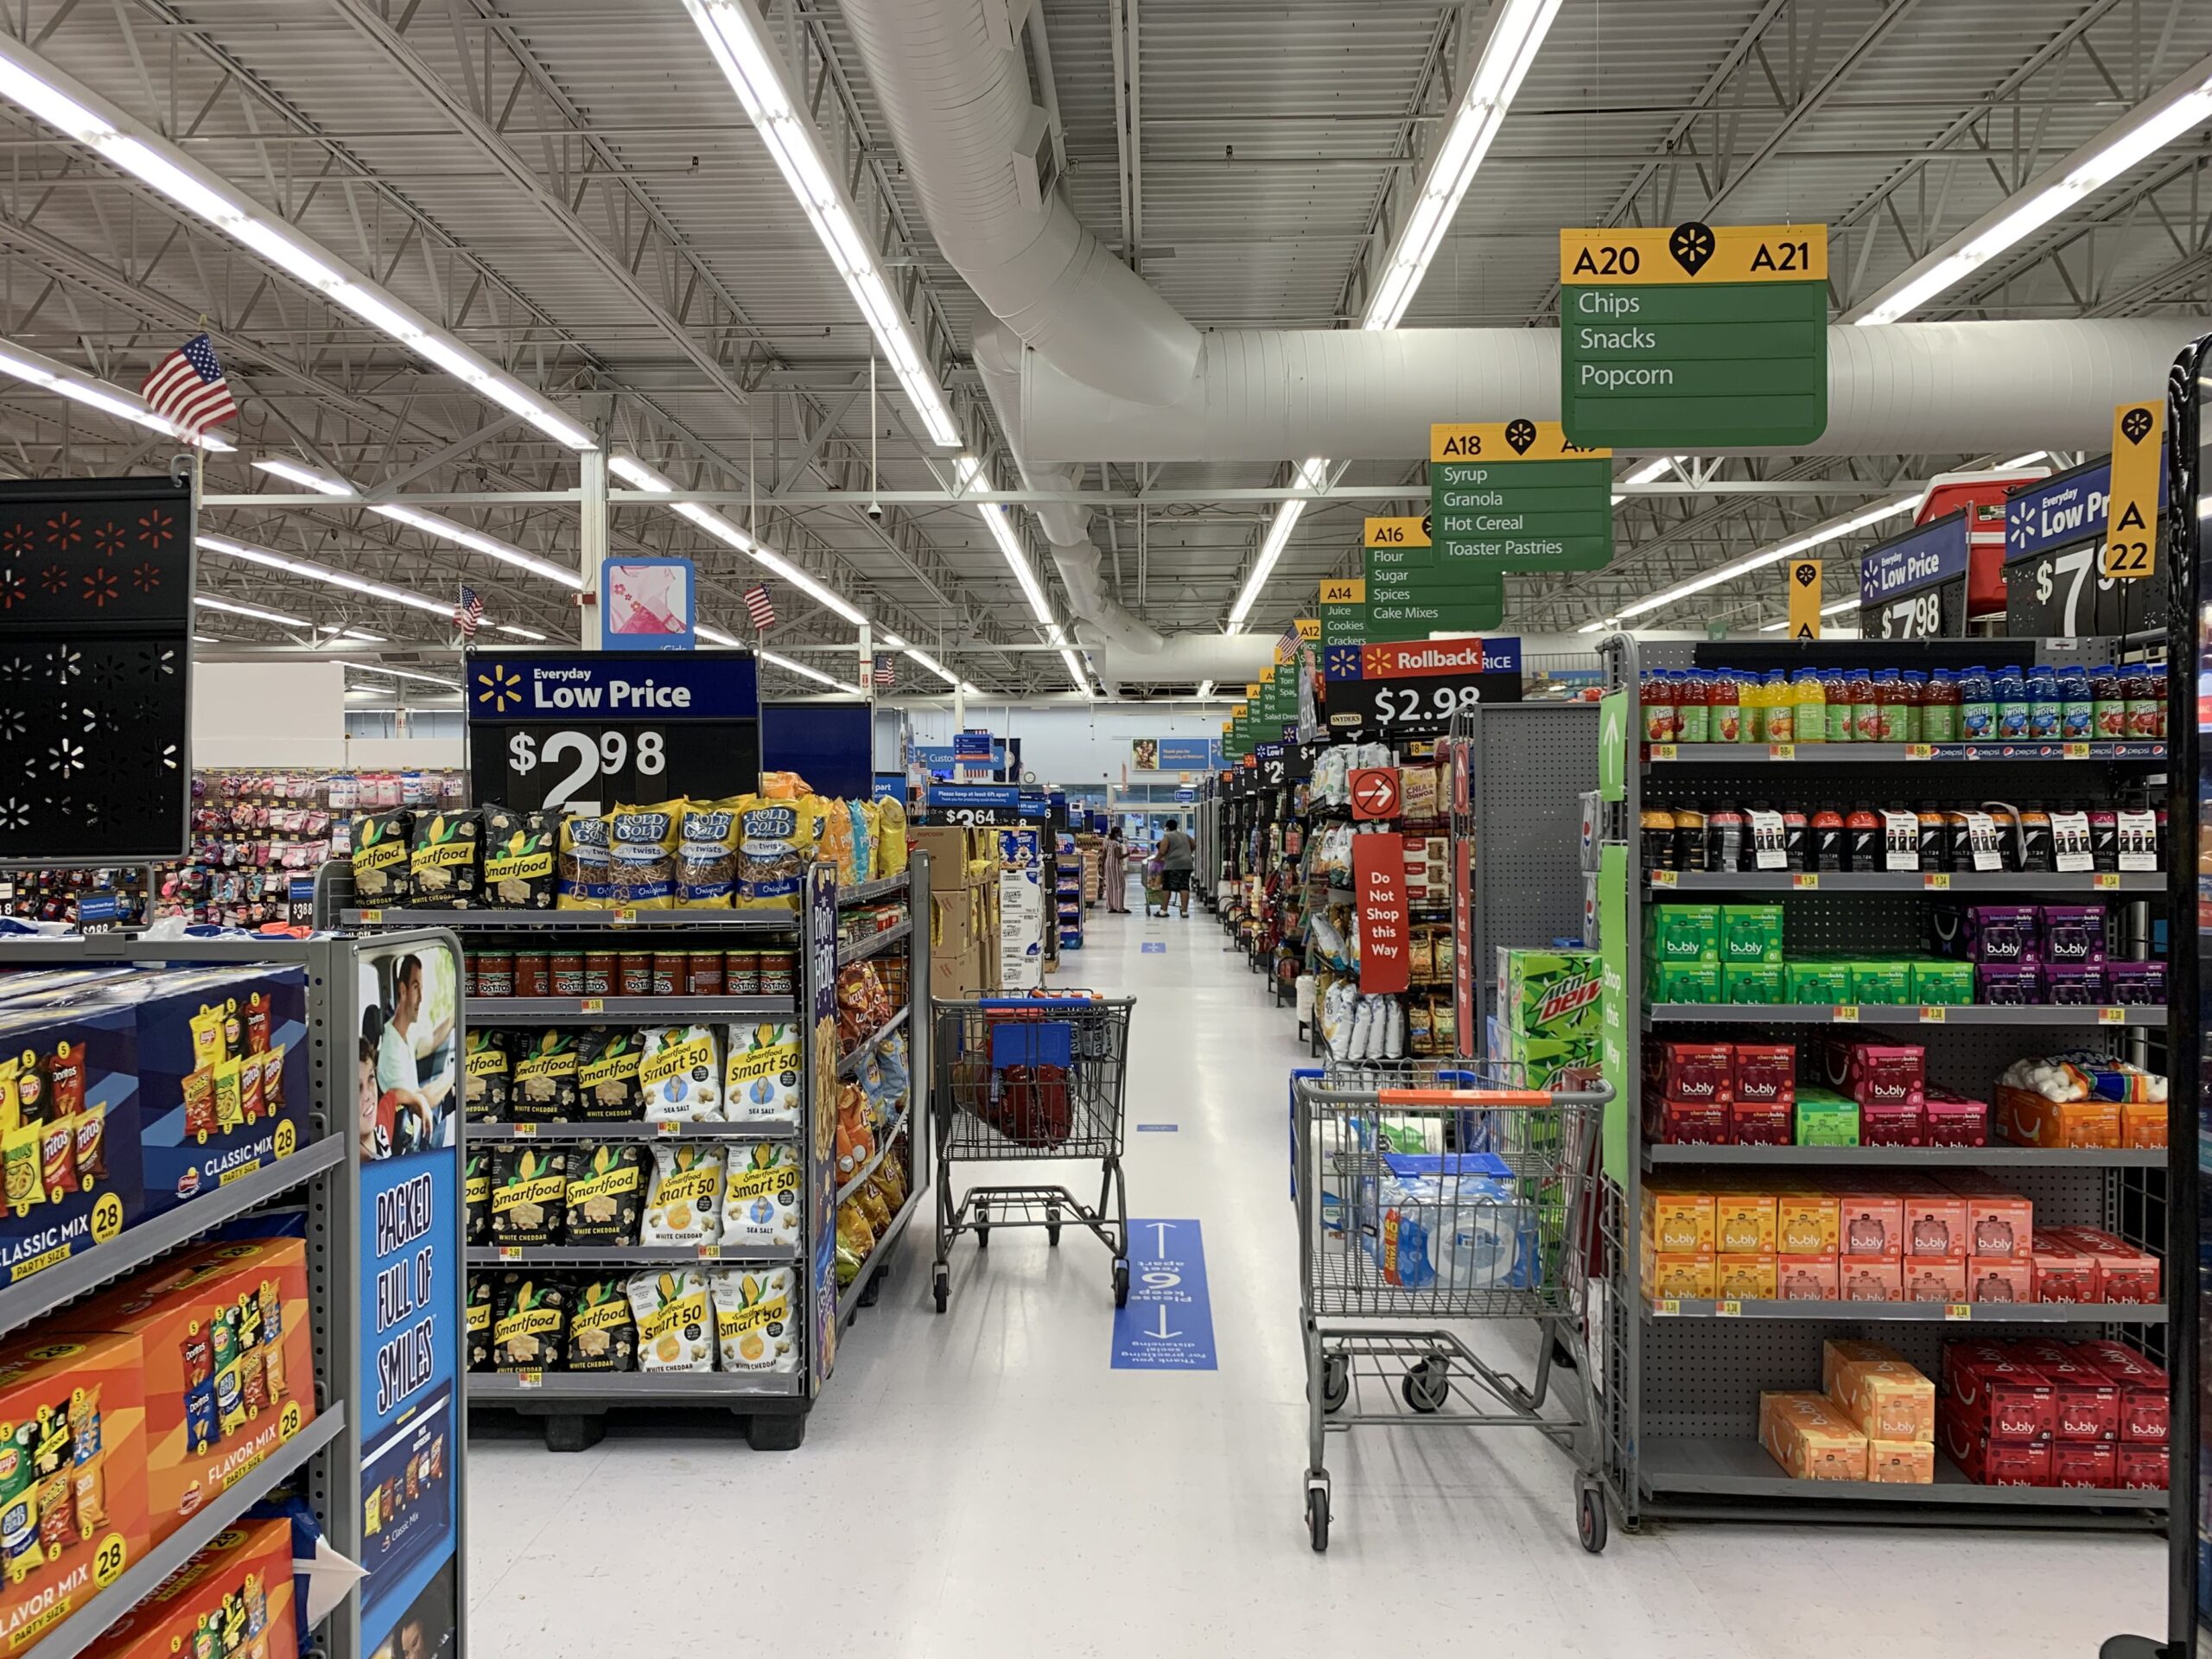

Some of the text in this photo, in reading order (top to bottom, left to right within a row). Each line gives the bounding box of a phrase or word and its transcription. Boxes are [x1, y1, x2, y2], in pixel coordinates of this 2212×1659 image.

[1573, 246, 1640, 275] A20
[1750, 242, 1809, 272] A21
[1579, 292, 1640, 315] Chips
[1580, 328, 1656, 349] Snacks
[1581, 365, 1674, 390] Popcorn
[1443, 436, 1482, 455] A18
[1444, 467, 1488, 485] Syrup
[1444, 492, 1503, 507] Granola
[2042, 488, 2078, 509] Everyday
[1444, 516, 1523, 531] Hot Cereal
[2042, 505, 2083, 537] Low
[2116, 501, 2145, 531] A
[1374, 527, 1404, 543] A16
[1374, 551, 1404, 562] Flour
[1446, 540, 1562, 556] Toaster Pastries
[2110, 543, 2147, 571] 22
[1881, 553, 1902, 567] Everyday
[1374, 570, 1408, 583] Sugar
[1881, 553, 1939, 591] Low Price
[1327, 588, 1351, 600] A14
[1374, 589, 1410, 601] Spices
[1327, 607, 1351, 616] Juice
[1374, 607, 1439, 619] Cake Mixes
[1300, 626, 1319, 636] A12
[1327, 620, 1363, 631] Cookies
[1327, 636, 1366, 645] Crackers
[1398, 648, 1511, 670] Rollback RICE
[534, 668, 591, 681] Everyday
[534, 679, 690, 709] Low Price
[1375, 686, 1480, 725] $2.98
[929, 753, 954, 762] Custo
[1406, 785, 1425, 795] CHIA
[1406, 790, 1433, 799] QUINOA
[752, 809, 790, 821] ROLD
[745, 820, 790, 836] GOLD
[412, 847, 469, 868] martfood
[632, 847, 661, 855] twists
[485, 857, 547, 878] Smartfood
[1371, 872, 1390, 884] Do
[762, 882, 791, 893] Original
[1370, 890, 1394, 902] Not
[294, 903, 313, 919] $388
[1367, 908, 1399, 922] Shop
[815, 906, 834, 944] PARTY
[1372, 926, 1396, 938] this
[1372, 944, 1398, 958] Way
[1667, 941, 1700, 954] bubly
[2055, 943, 2087, 956] bubly
[815, 944, 835, 998] HERE
[1605, 963, 1621, 996] Shop
[1606, 1002, 1618, 1027] this
[690, 1048, 708, 1064] 50
[1606, 1037, 1620, 1071] Way
[54, 1066, 77, 1082] Doritos
[731, 1054, 798, 1081] Smart 50
[667, 1122, 678, 1132] 2.98
[205, 1135, 273, 1176] CLASSIC MIX
[223, 1161, 257, 1183] PARTY SIZE
[568, 1173, 633, 1202] Smartfood
[96, 1204, 118, 1233] 28
[376, 1172, 432, 1258] PACKED
[0, 1214, 89, 1267] LASSIC MIX
[1664, 1233, 1696, 1246] bubly
[1851, 1236, 1883, 1249] bubly
[16, 1248, 66, 1277] PARTY SIZE
[377, 1246, 432, 1333] FULL OF
[1141, 1272, 1181, 1289] 6
[494, 1314, 556, 1338] Smartfood
[377, 1317, 433, 1415] SMILES
[2001, 1421, 2035, 1433] bubly
[208, 1424, 276, 1484] FLAVOR MIX
[226, 1454, 261, 1485] PARTY SIZE
[391, 1512, 420, 1541] Classic Mix
[98, 1543, 121, 1579] 28
[0, 1563, 89, 1637] LAVOR MIX
[15, 1603, 66, 1643] PARTY SIZE
